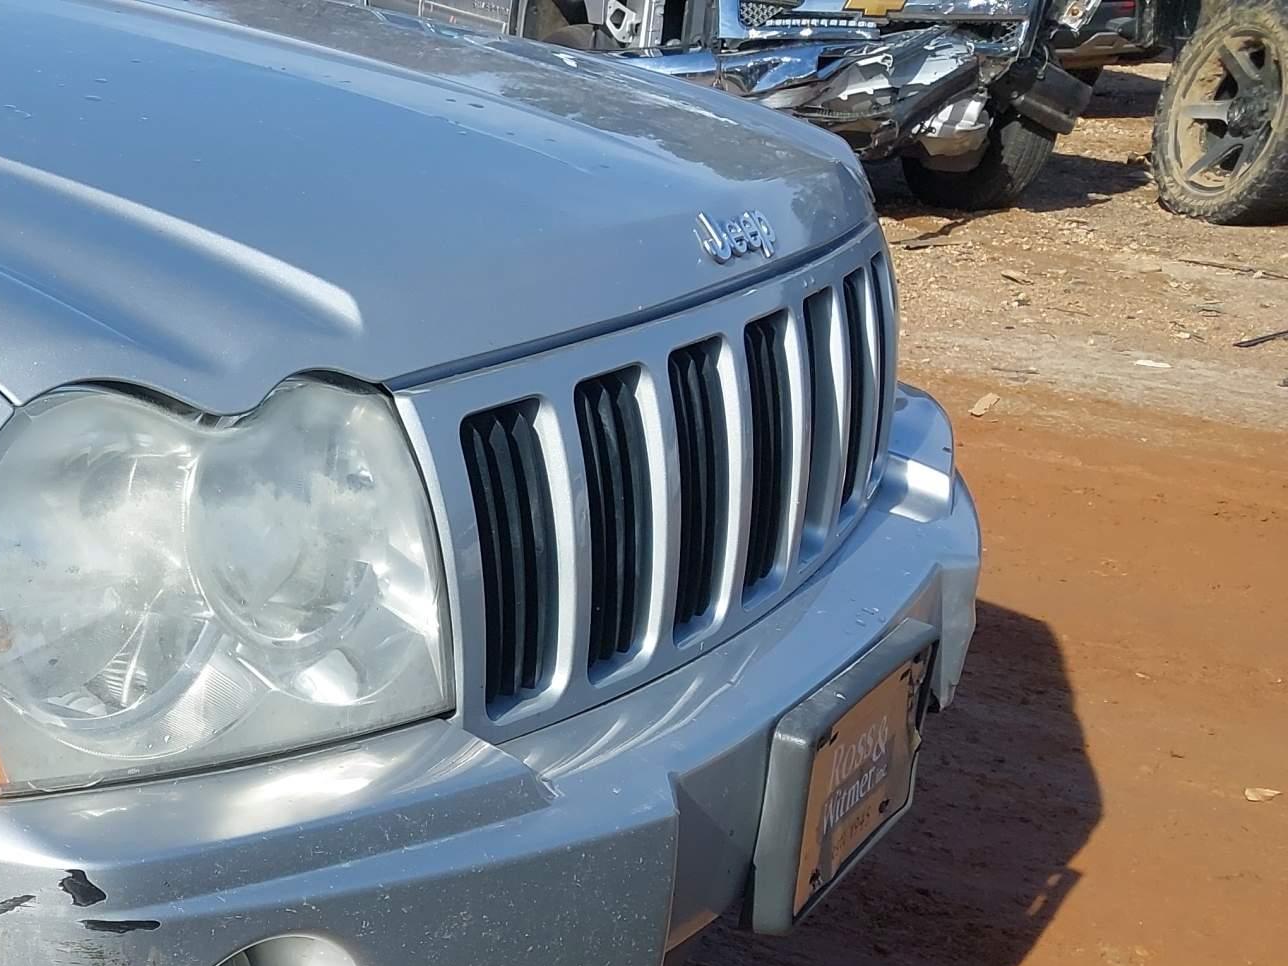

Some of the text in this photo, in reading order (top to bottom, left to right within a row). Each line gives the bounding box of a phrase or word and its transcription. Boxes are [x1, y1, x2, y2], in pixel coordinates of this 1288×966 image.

[694, 210, 775, 260] Jeep
[828, 714, 888, 792] Ross &
[822, 765, 876, 835] Witmer
